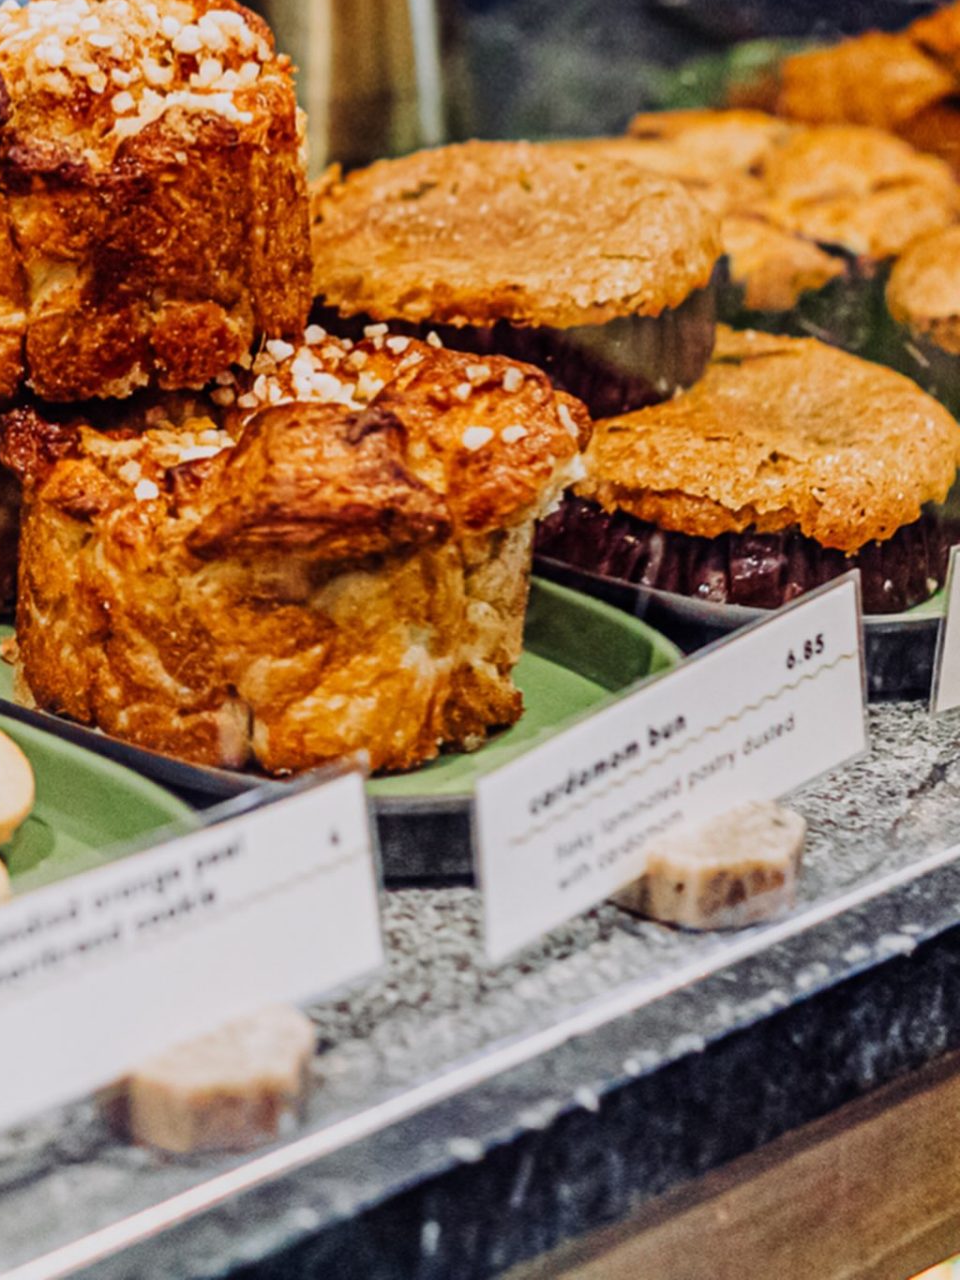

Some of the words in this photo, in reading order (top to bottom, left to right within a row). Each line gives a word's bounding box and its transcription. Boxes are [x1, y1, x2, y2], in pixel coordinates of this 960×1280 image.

[529, 741, 640, 815] cardamom
[647, 715, 686, 747] bun
[785, 633, 825, 670] 6.85
[688, 749, 736, 790] pastry
[742, 712, 795, 755] dusted
